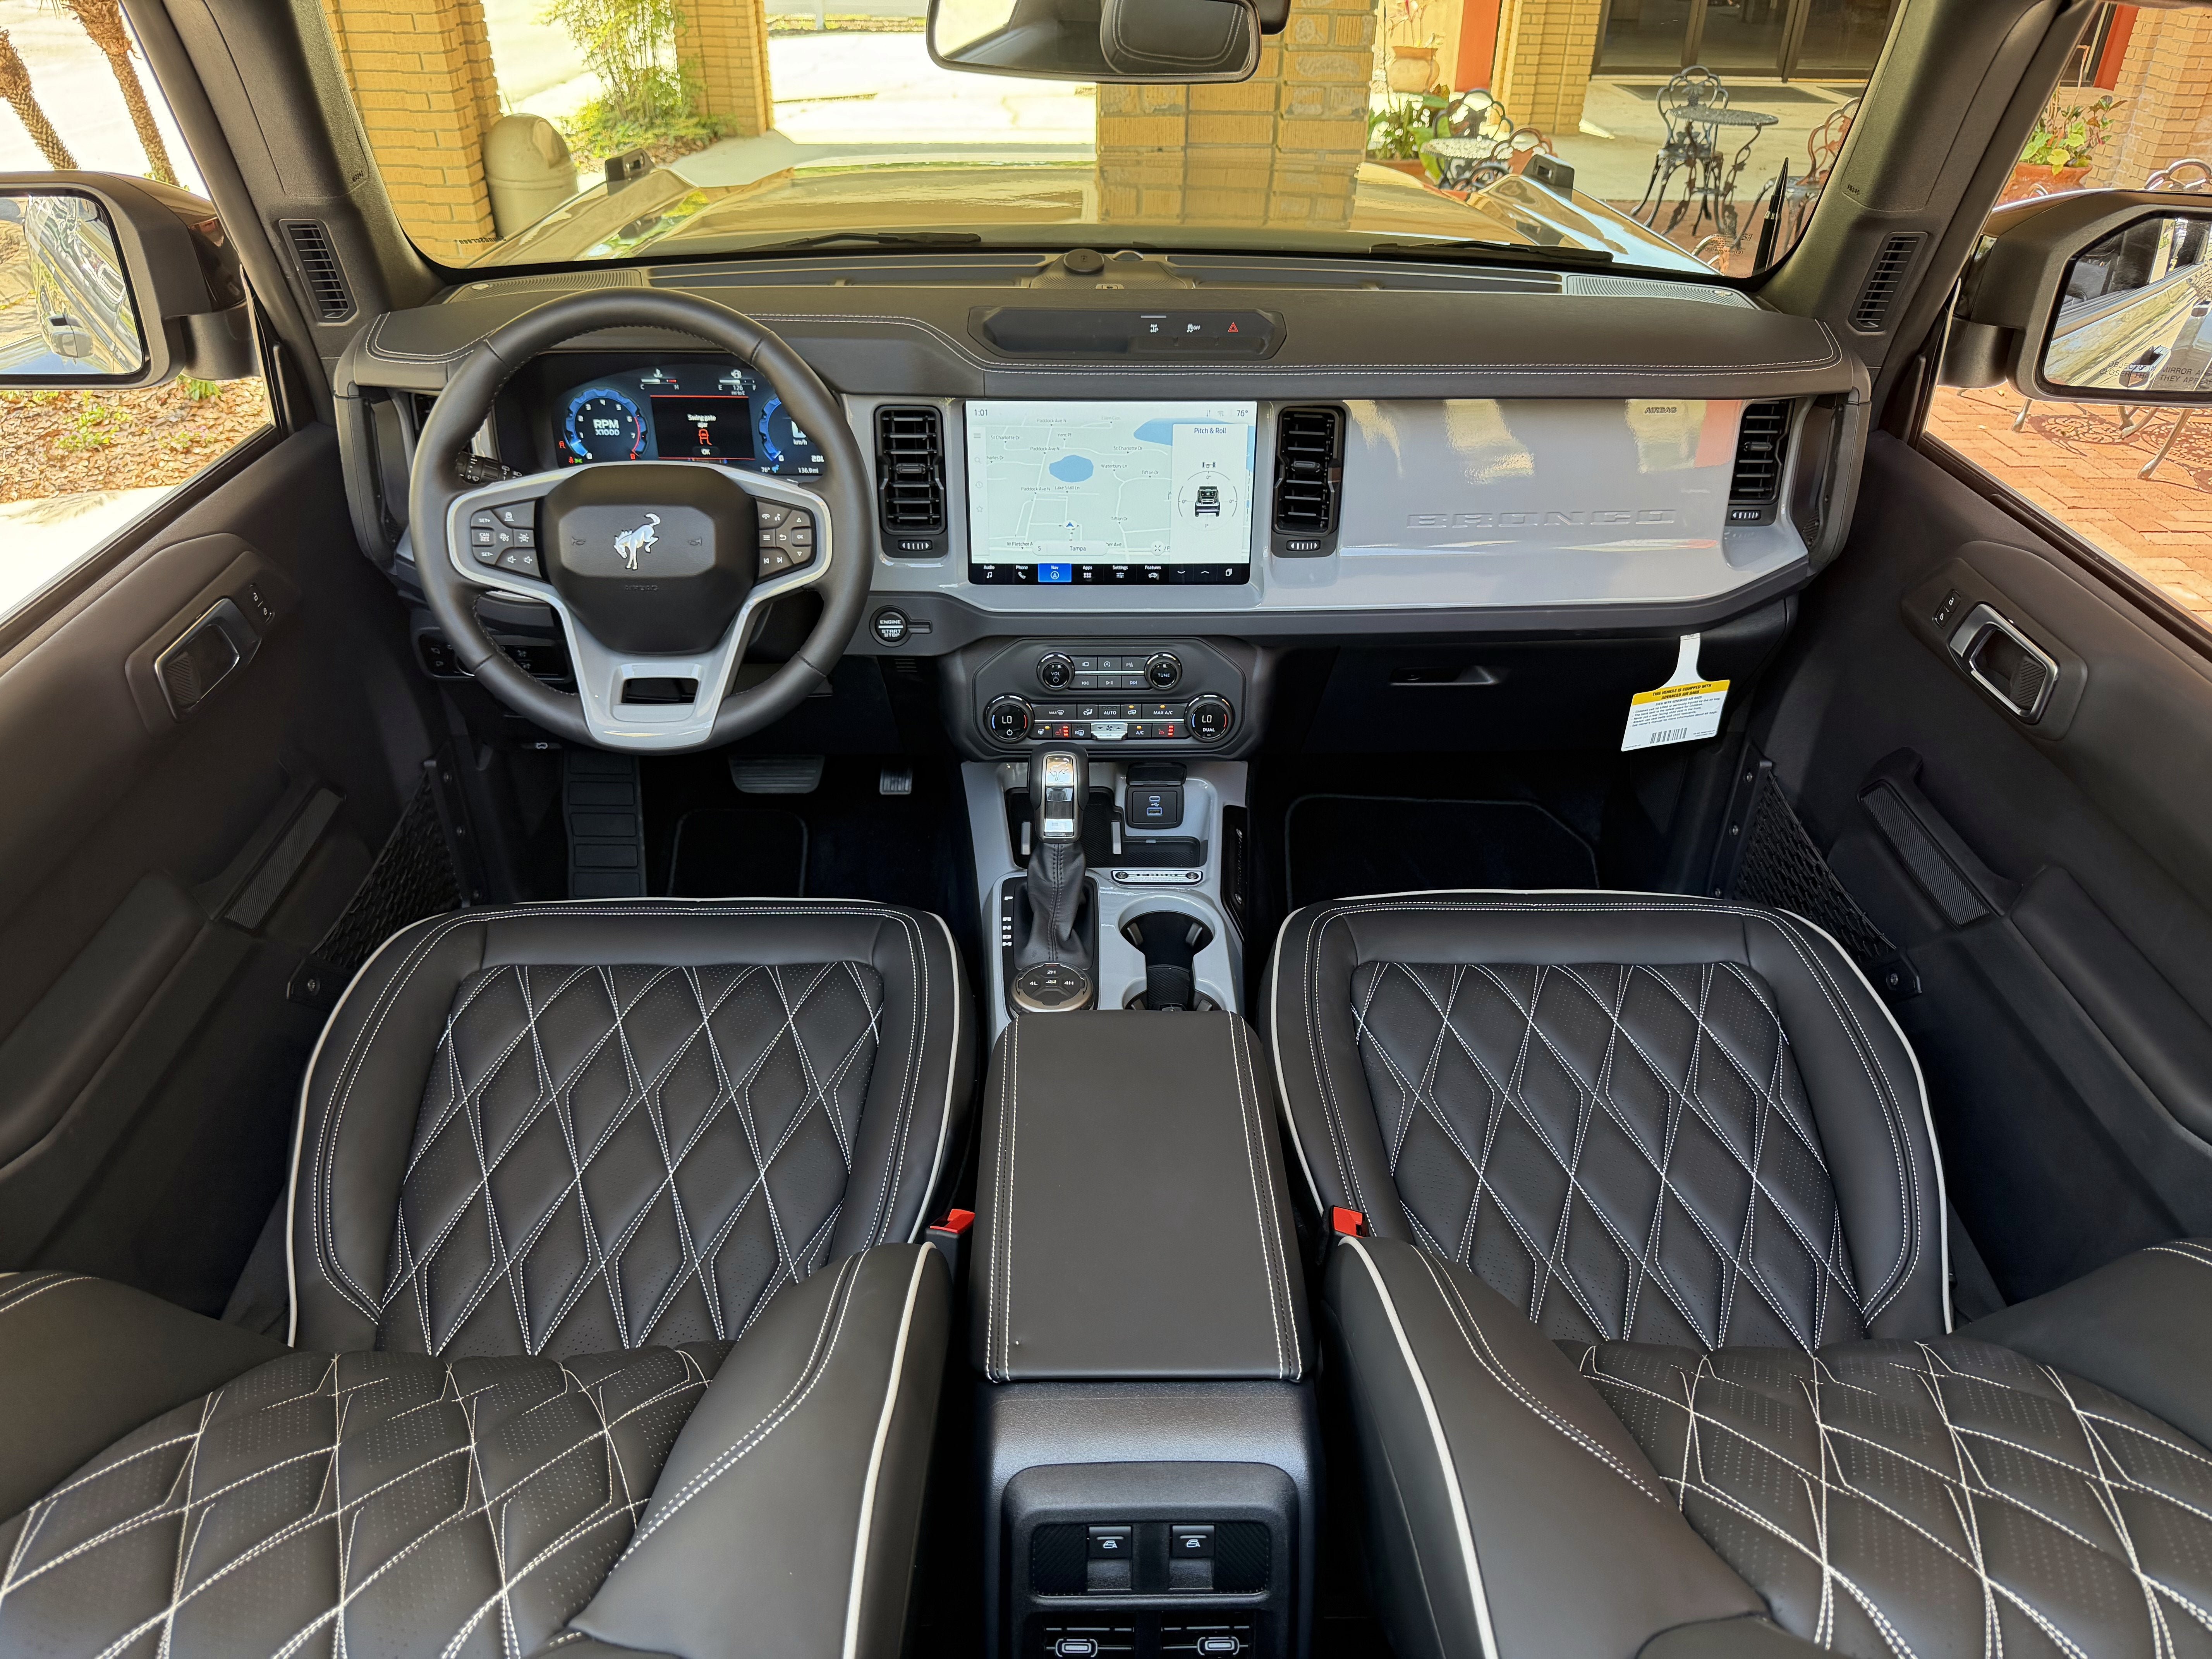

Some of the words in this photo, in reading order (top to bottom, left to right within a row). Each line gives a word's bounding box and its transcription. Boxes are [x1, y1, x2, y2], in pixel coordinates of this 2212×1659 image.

[687, 414, 704, 422] Swing
[593, 419, 620, 429] RPM
[1406, 509, 1676, 529] BRONCO
